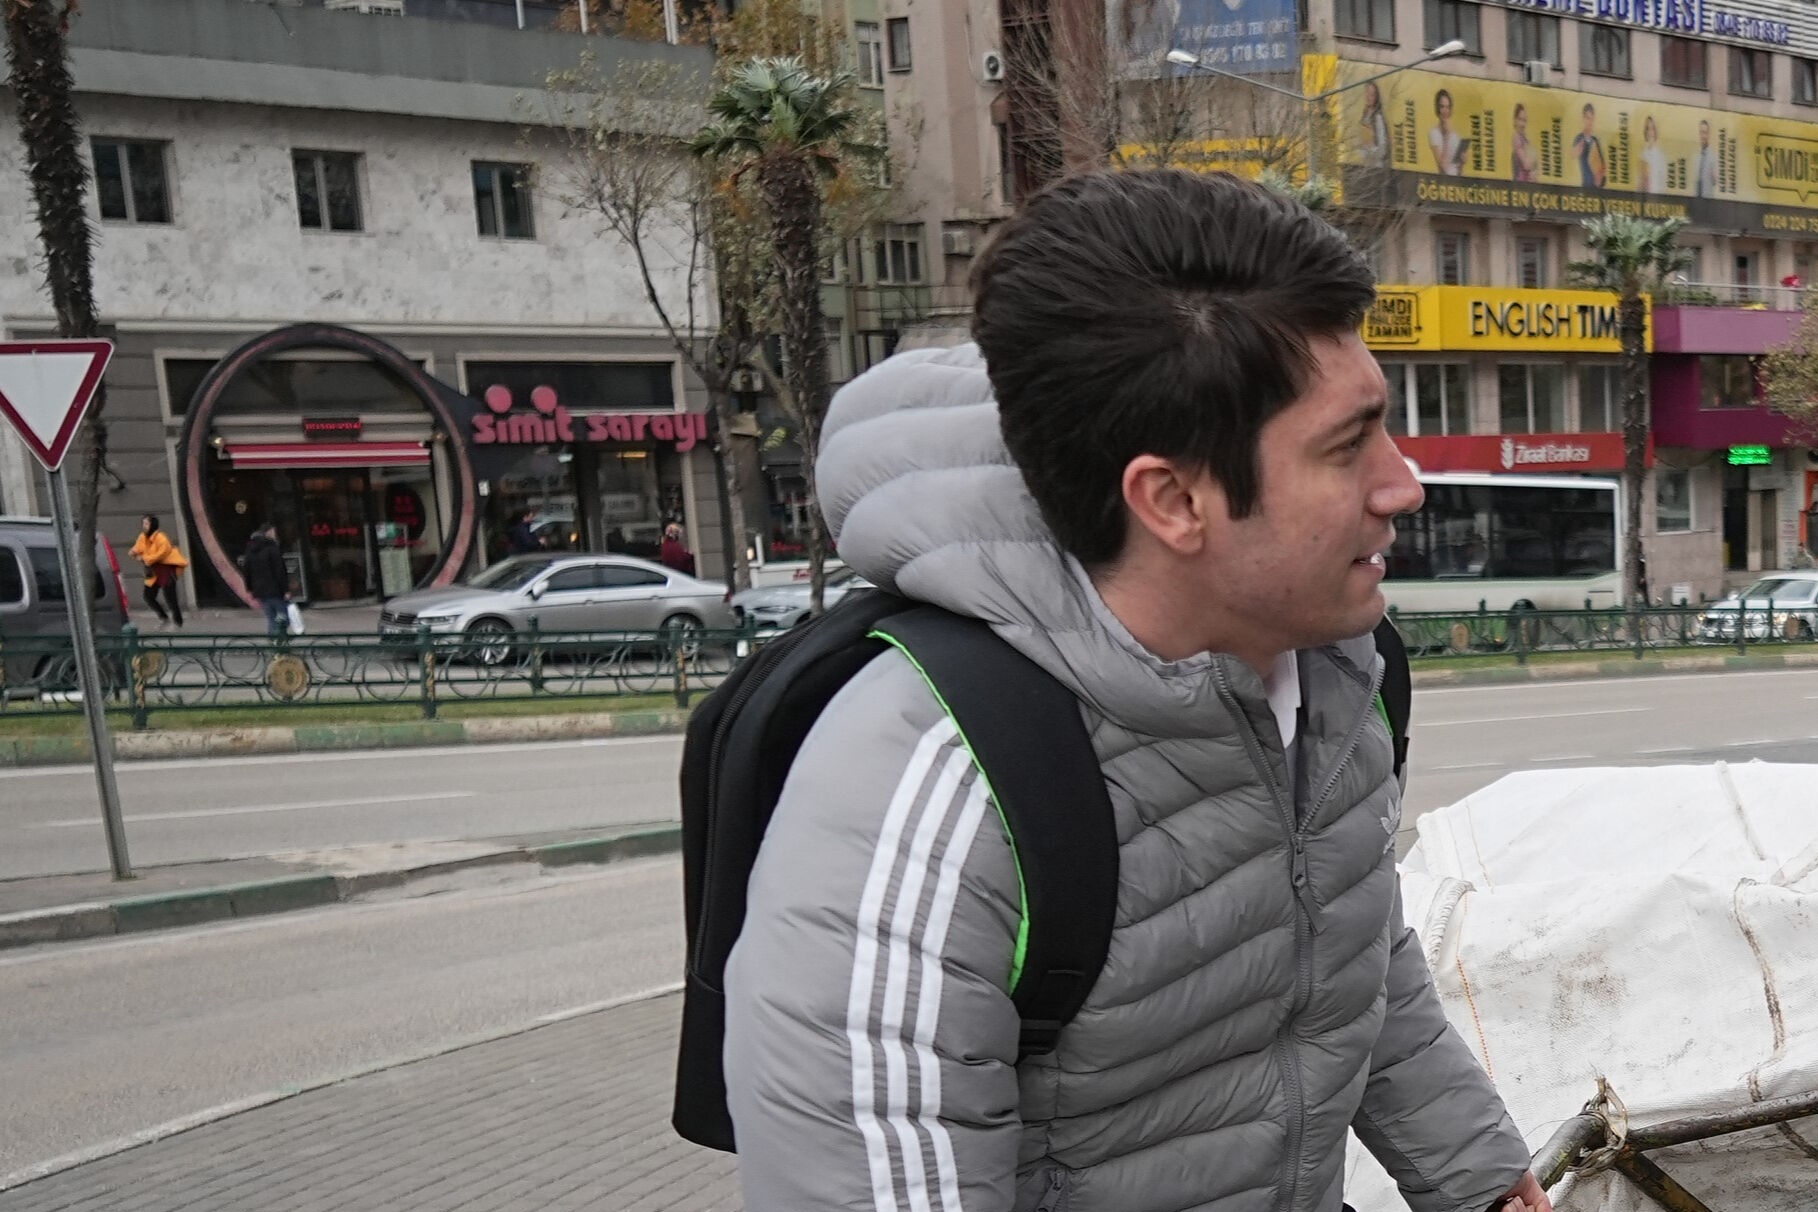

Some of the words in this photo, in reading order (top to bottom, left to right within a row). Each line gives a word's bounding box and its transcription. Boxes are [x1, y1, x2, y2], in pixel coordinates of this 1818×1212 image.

[1417, 179, 1509, 207] ÖĞRENCİSİNE
[1511, 190, 1530, 208] EN
[1532, 193, 1559, 214] ÇOK
[1560, 190, 1601, 213] DEĞER
[1471, 301, 1571, 338] ENGLISH
[1576, 304, 1622, 340] TIM
[473, 385, 574, 444] simit
[586, 412, 708, 453] sarayı
[1516, 444, 1547, 464] Ziraat
[1548, 444, 1590, 463] Bankası
